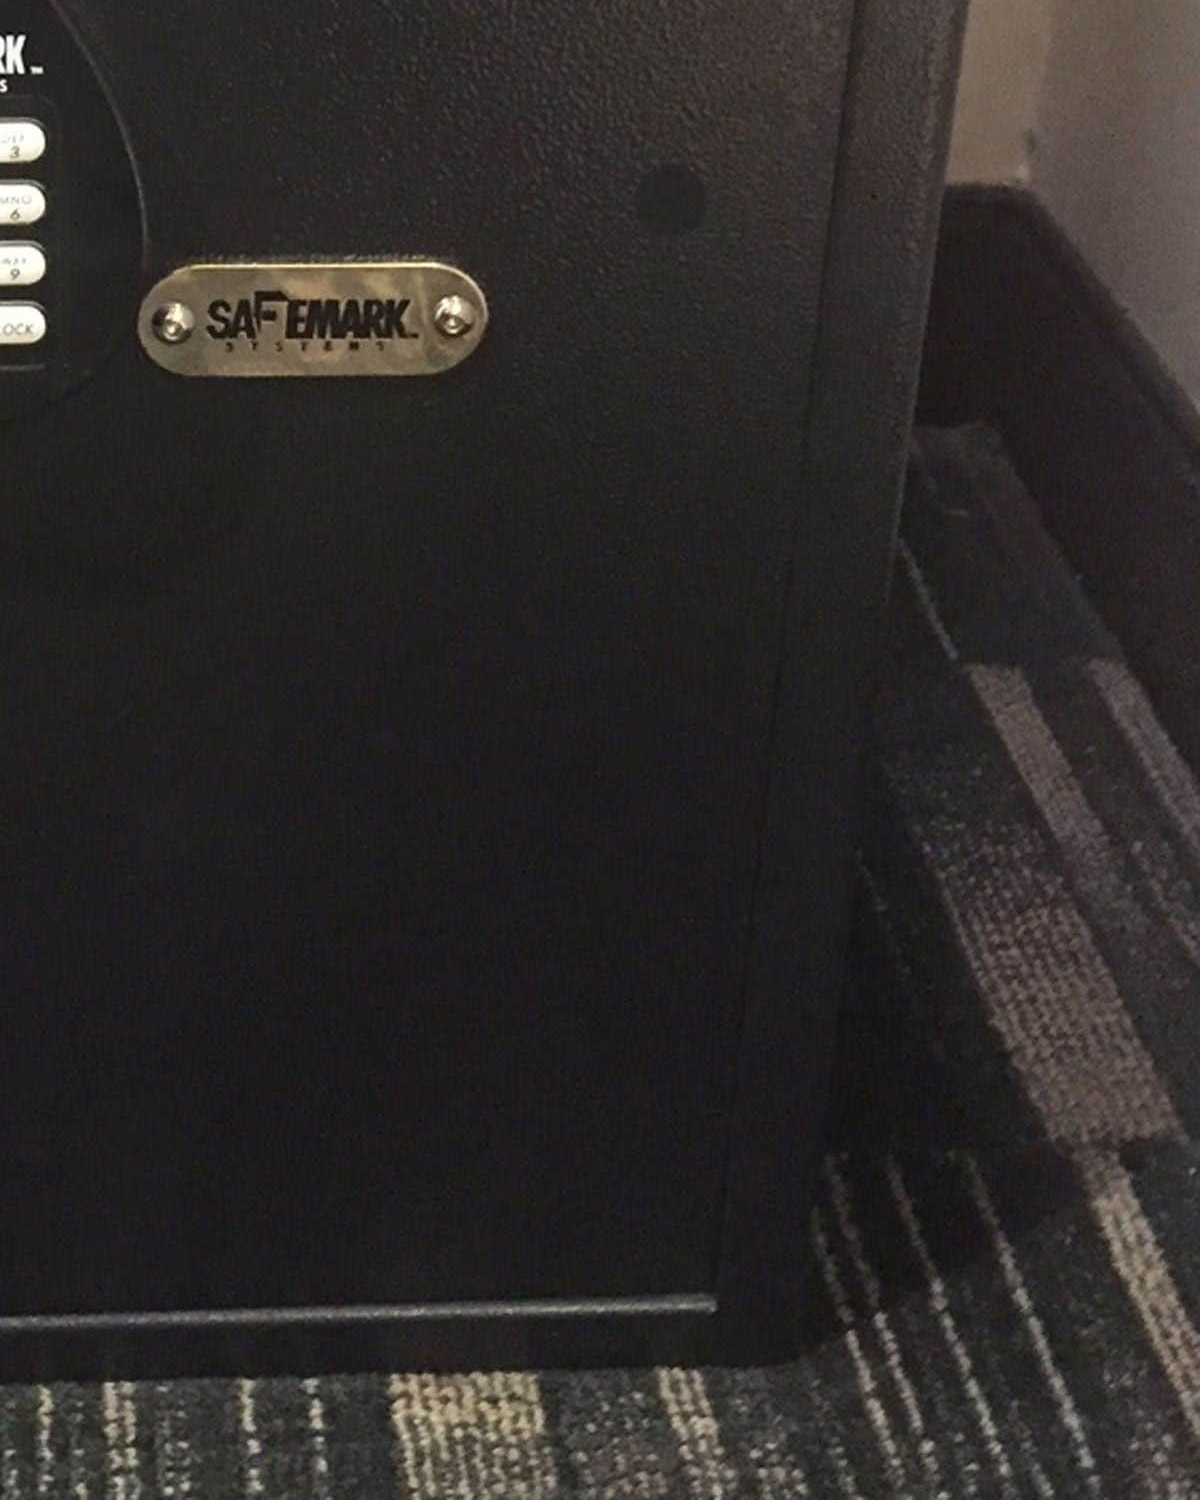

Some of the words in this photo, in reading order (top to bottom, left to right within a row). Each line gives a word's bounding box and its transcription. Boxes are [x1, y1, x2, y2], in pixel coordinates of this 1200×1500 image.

[10, 147, 20, 159] 3
[10, 208, 20, 221] 6
[10, 268, 20, 280] 9
[207, 291, 411, 339] SAFEMARK
